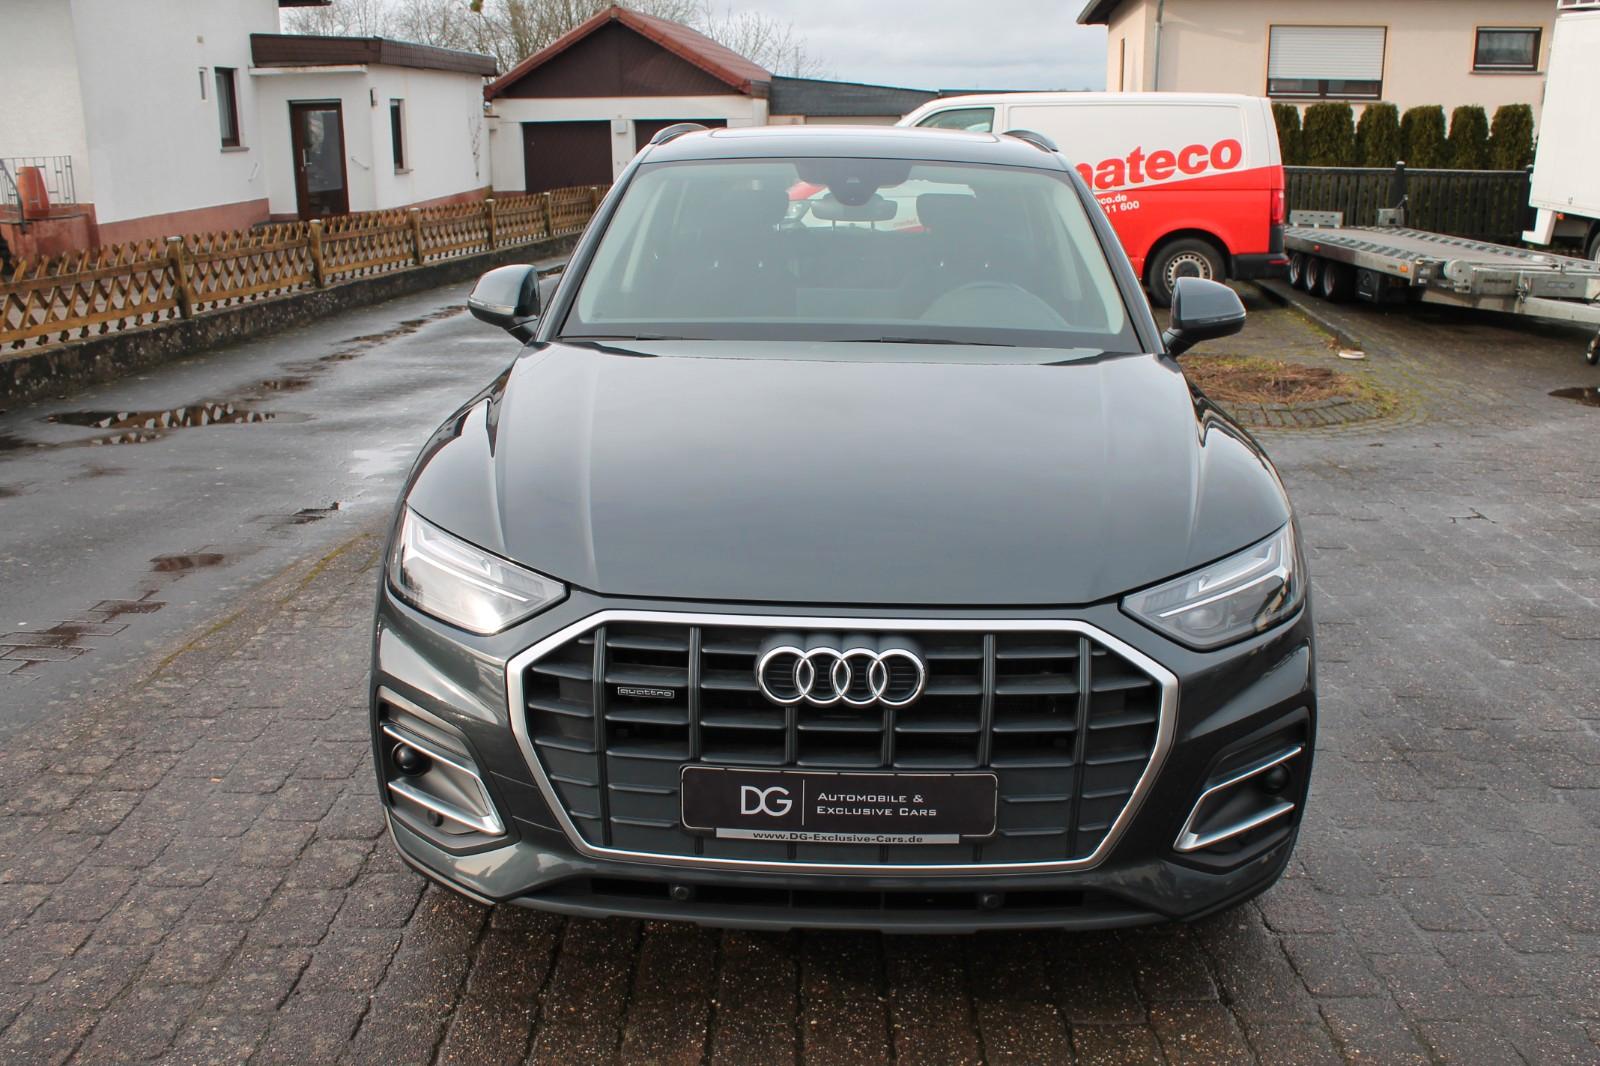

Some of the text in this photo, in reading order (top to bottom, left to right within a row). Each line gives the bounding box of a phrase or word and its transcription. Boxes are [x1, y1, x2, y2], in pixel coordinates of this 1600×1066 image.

[1098, 193, 1127, 205] co.de
[1120, 200, 1140, 211] 600
[740, 785, 793, 817] DG
[817, 792, 924, 804] AUTOMOBILE &
[816, 805, 937, 817] EXCLUSIVE CARS
[752, 831, 923, 844] www.DG-Exclusive-Cars.de
